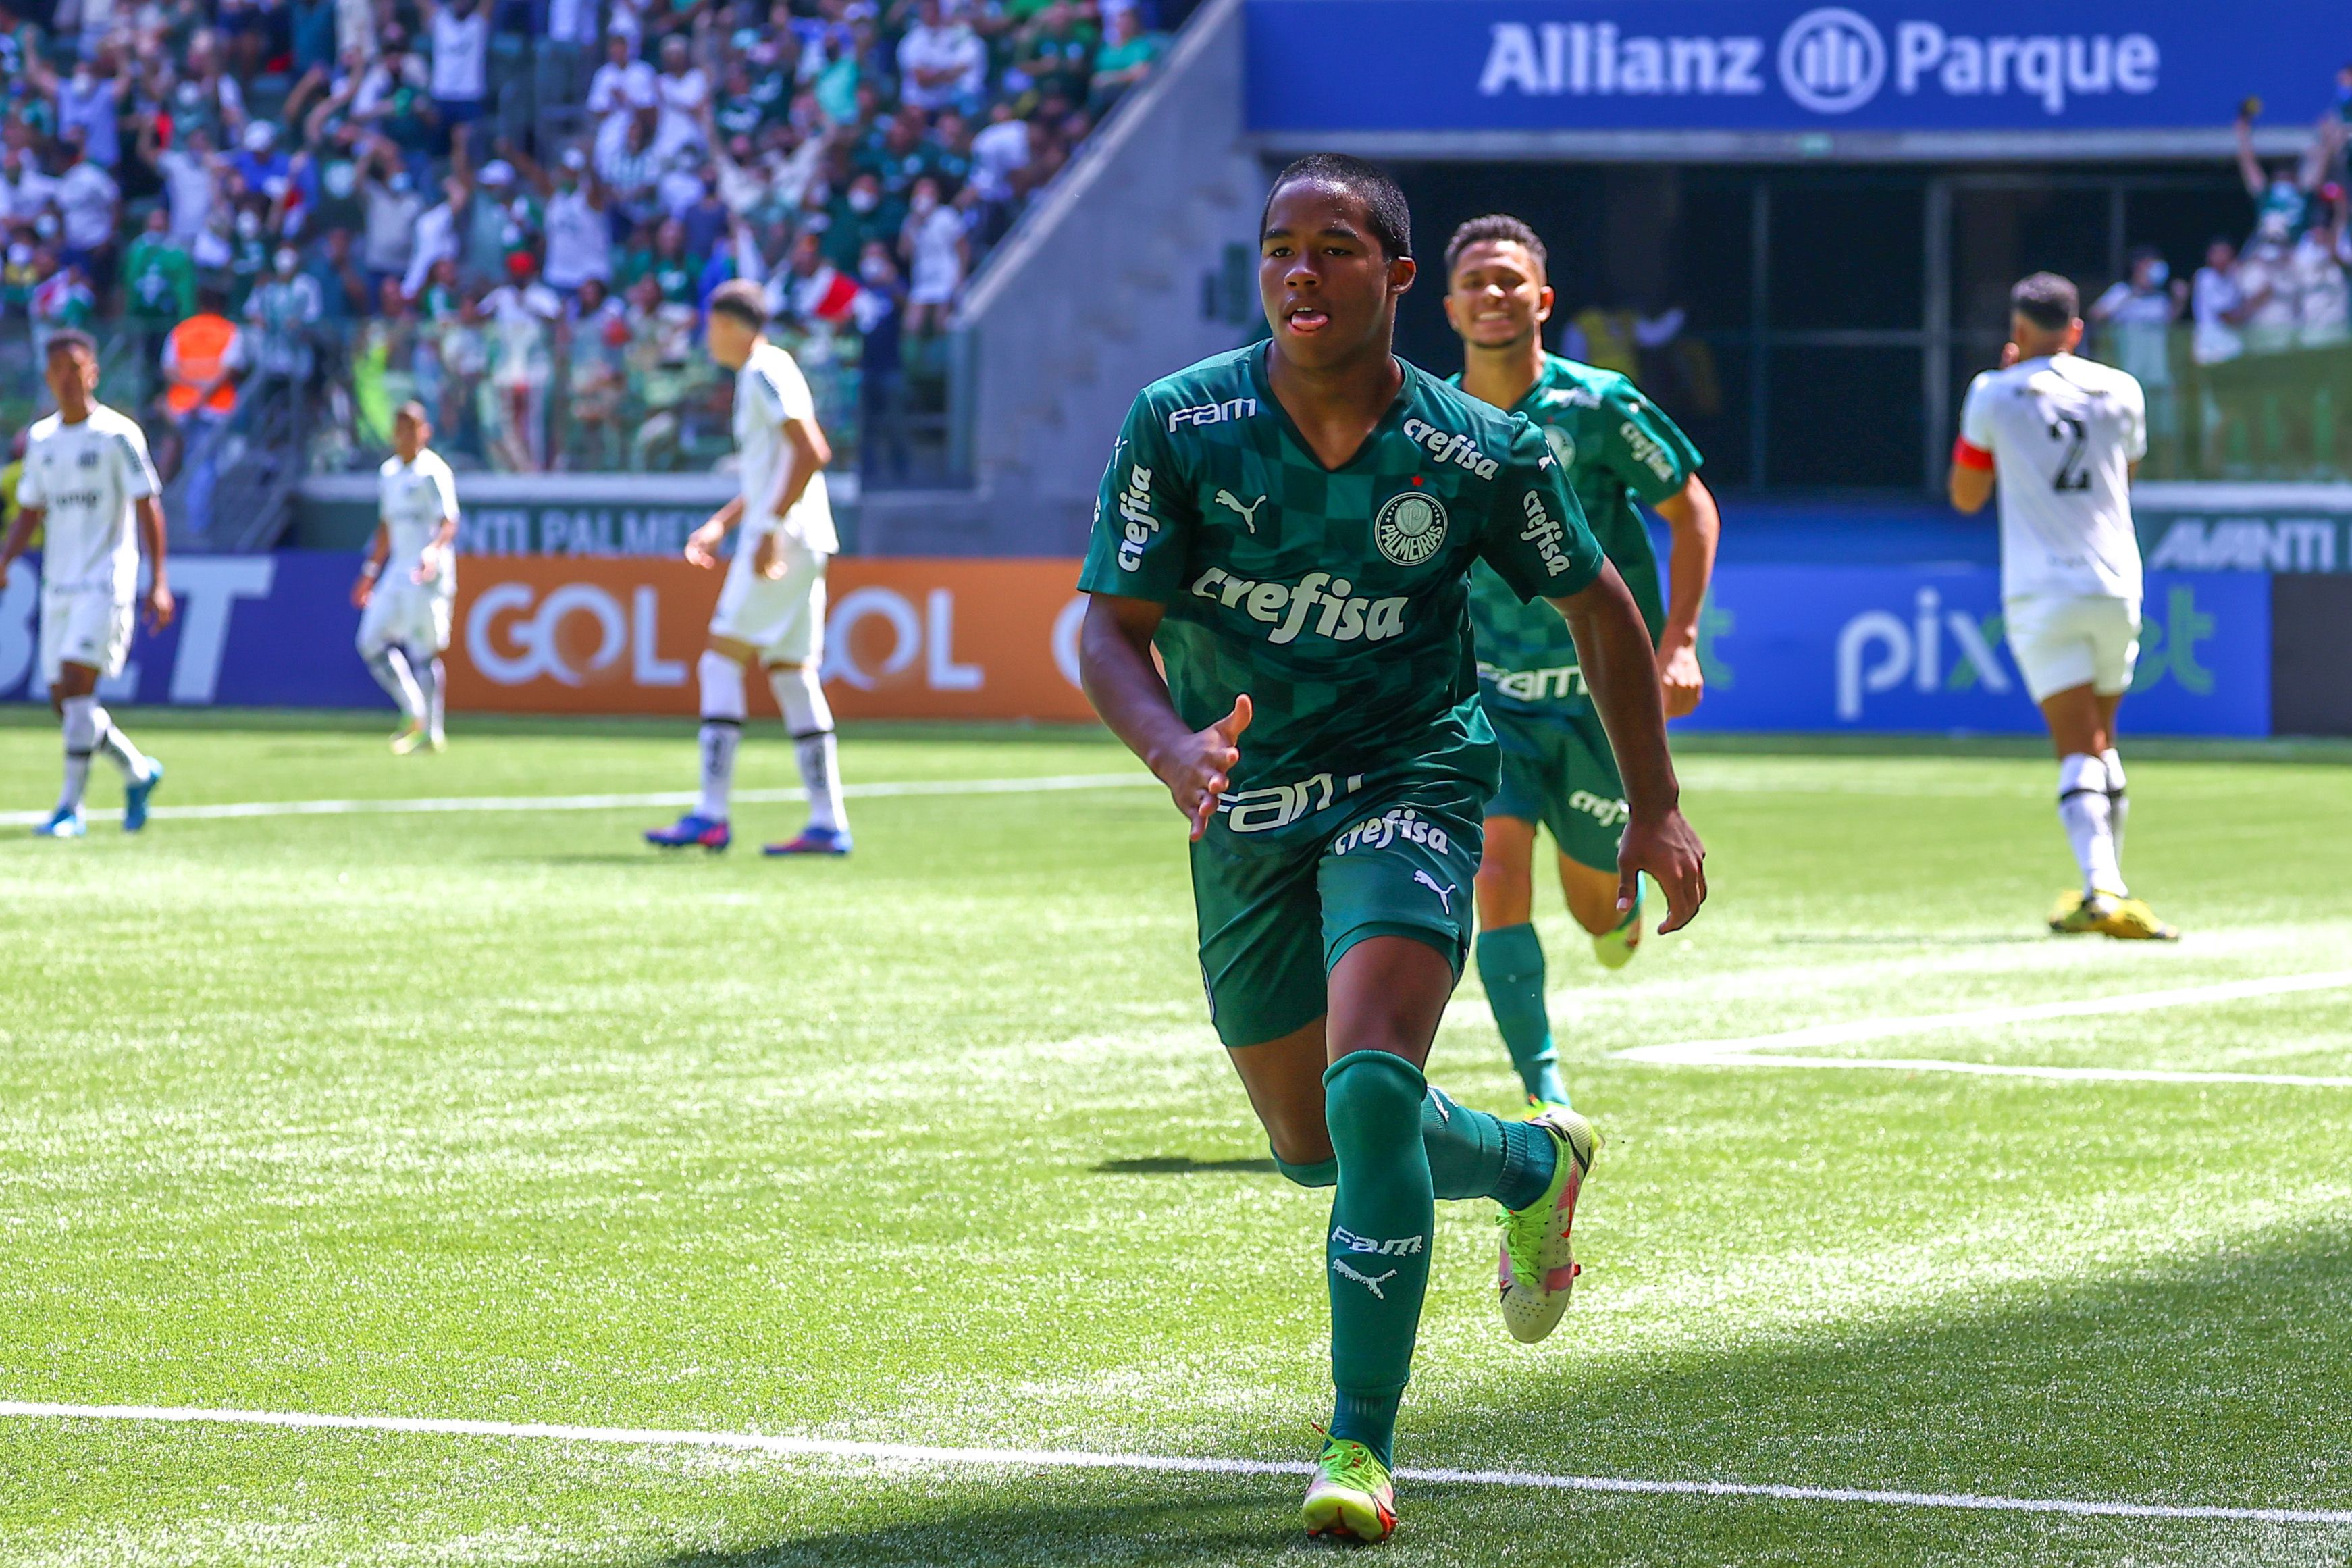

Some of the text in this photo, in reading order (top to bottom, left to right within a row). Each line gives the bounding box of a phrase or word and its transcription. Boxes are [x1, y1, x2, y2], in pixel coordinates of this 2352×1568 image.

[1480, 20, 2160, 115] Allianz Parque
[1403, 418, 1500, 481] crefisa
[2049, 408, 2091, 496] 2
[1118, 463, 1160, 572] crefisa
[1380, 524, 1444, 560] PALMEIRAS
[1520, 490, 1571, 577] crefisa
[2145, 517, 2337, 573] AVANTI
[464, 581, 689, 688] GOL
[820, 585, 985, 692] OL
[1191, 567, 1410, 644] crefisa
[1334, 809, 1449, 856] crefisa
